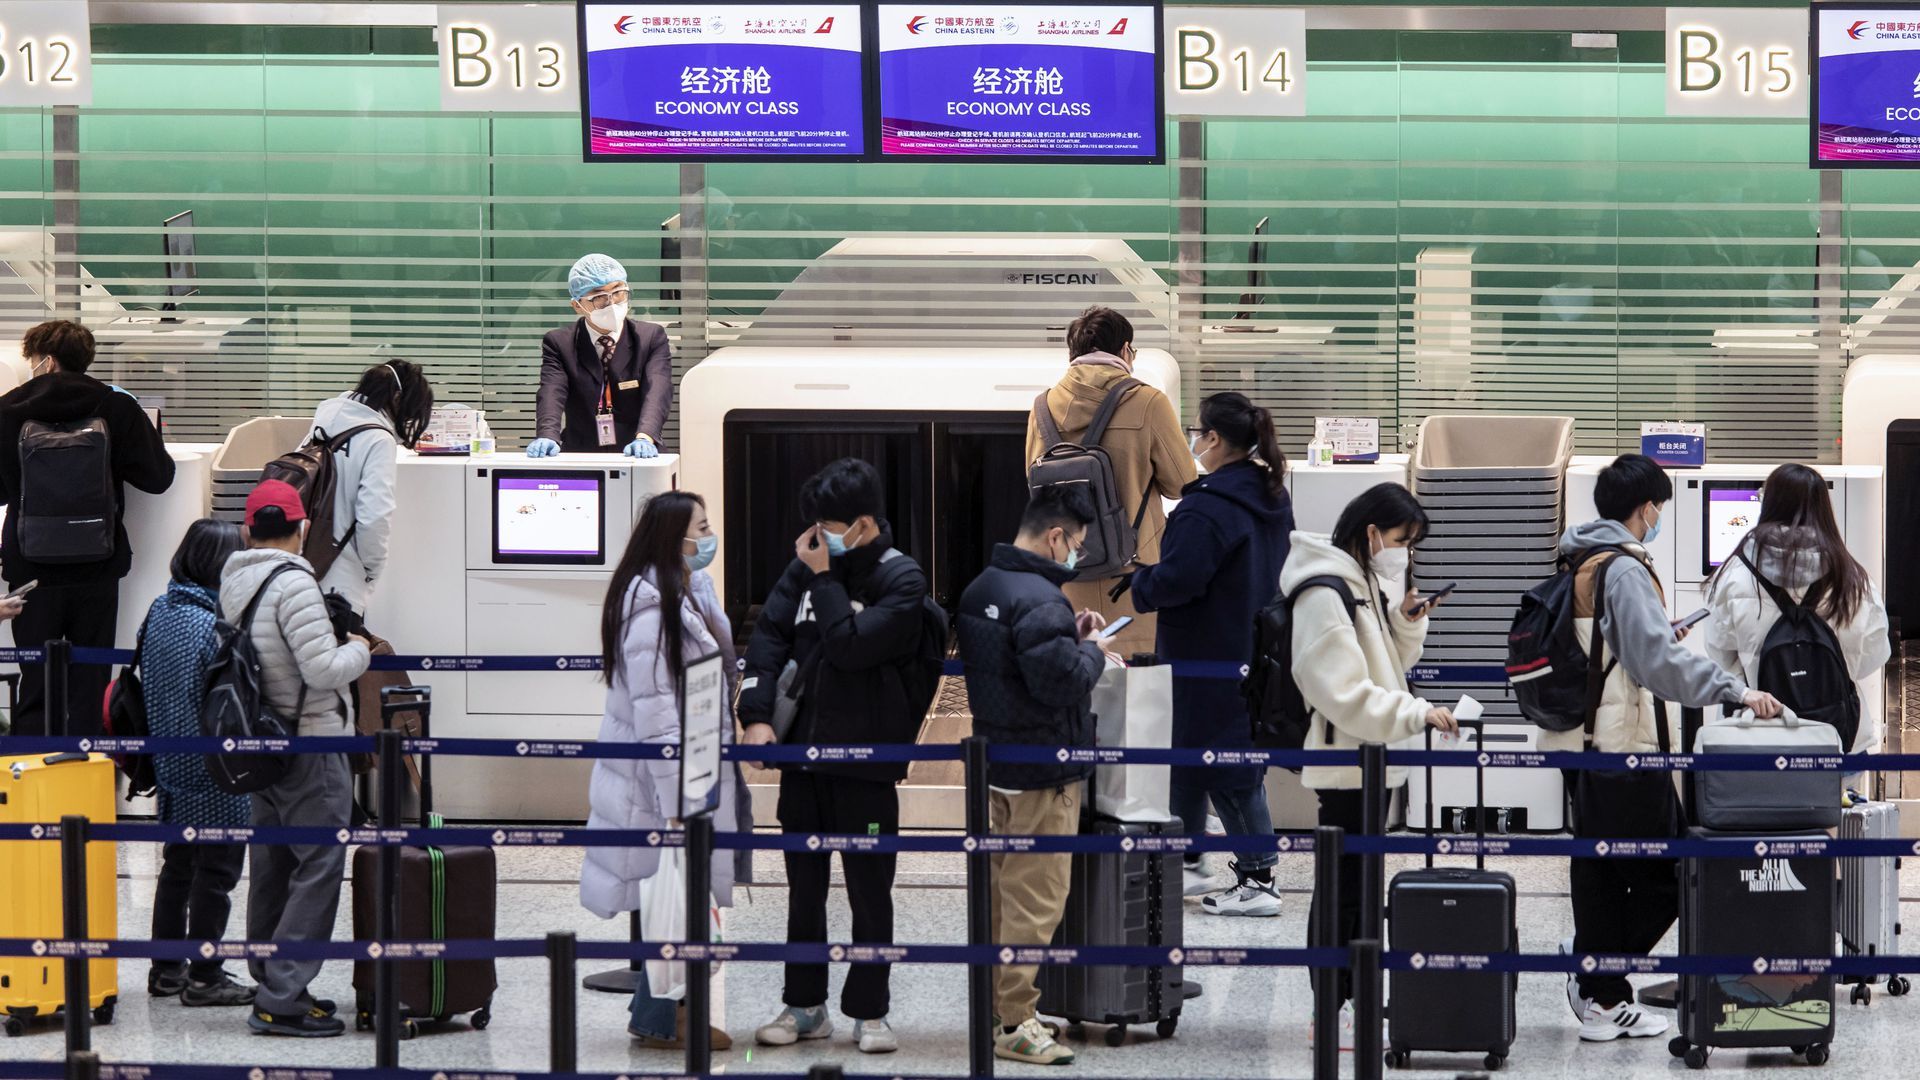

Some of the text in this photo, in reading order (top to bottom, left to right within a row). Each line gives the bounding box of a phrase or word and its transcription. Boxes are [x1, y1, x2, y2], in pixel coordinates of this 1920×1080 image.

[642, 17, 701, 26] 中國東方航空
[935, 17, 995, 27] 中國東方航空
[0, 41, 73, 81] 12
[451, 27, 560, 87] B13
[1179, 30, 1290, 91] B14
[1680, 30, 1791, 92] B15
[680, 66, 771, 95] 经济舱
[973, 67, 1064, 96] 经济舱
[655, 101, 799, 115] ECONOMY CLASS
[947, 102, 1091, 116] ECONOMY CLASS
[1022, 273, 1096, 284] FISCAN
[1659, 442, 1687, 450] 柜台关闭
[1740, 869, 1779, 881] THE WAY
[1749, 880, 1780, 892] NORTH
